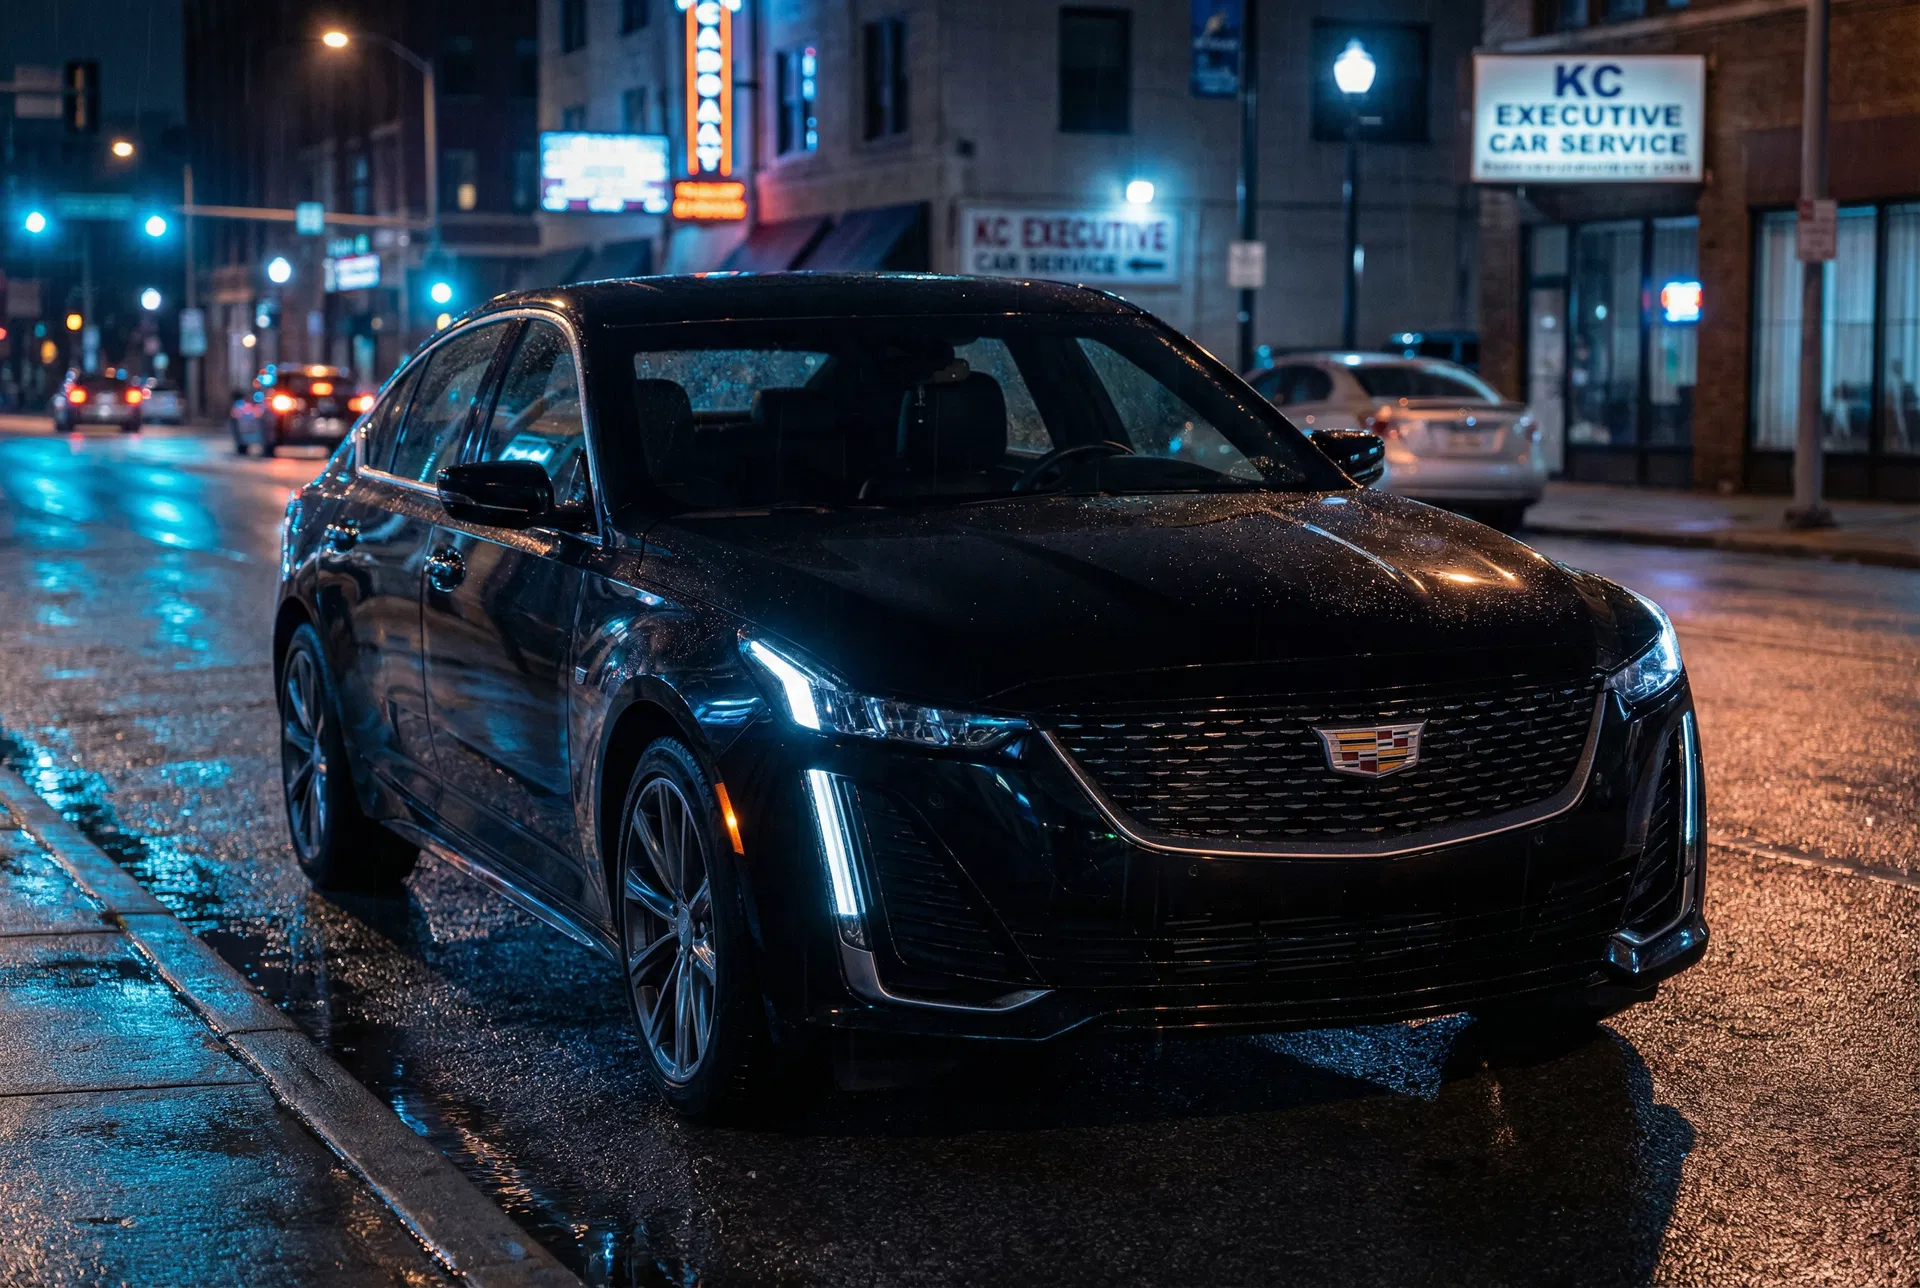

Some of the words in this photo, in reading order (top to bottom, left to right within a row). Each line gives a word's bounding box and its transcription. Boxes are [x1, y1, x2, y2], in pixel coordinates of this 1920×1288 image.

[1554, 64, 1624, 98] KC
[1496, 104, 1683, 127] EXECUTIVE
[1489, 133, 1548, 154] CAR
[1560, 133, 1687, 156] SERVICE
[974, 217, 1009, 249] KC
[1021, 217, 1167, 251] EXECUTIVE
[976, 253, 1017, 272] CAR
[1028, 253, 1116, 274] SERVICE
